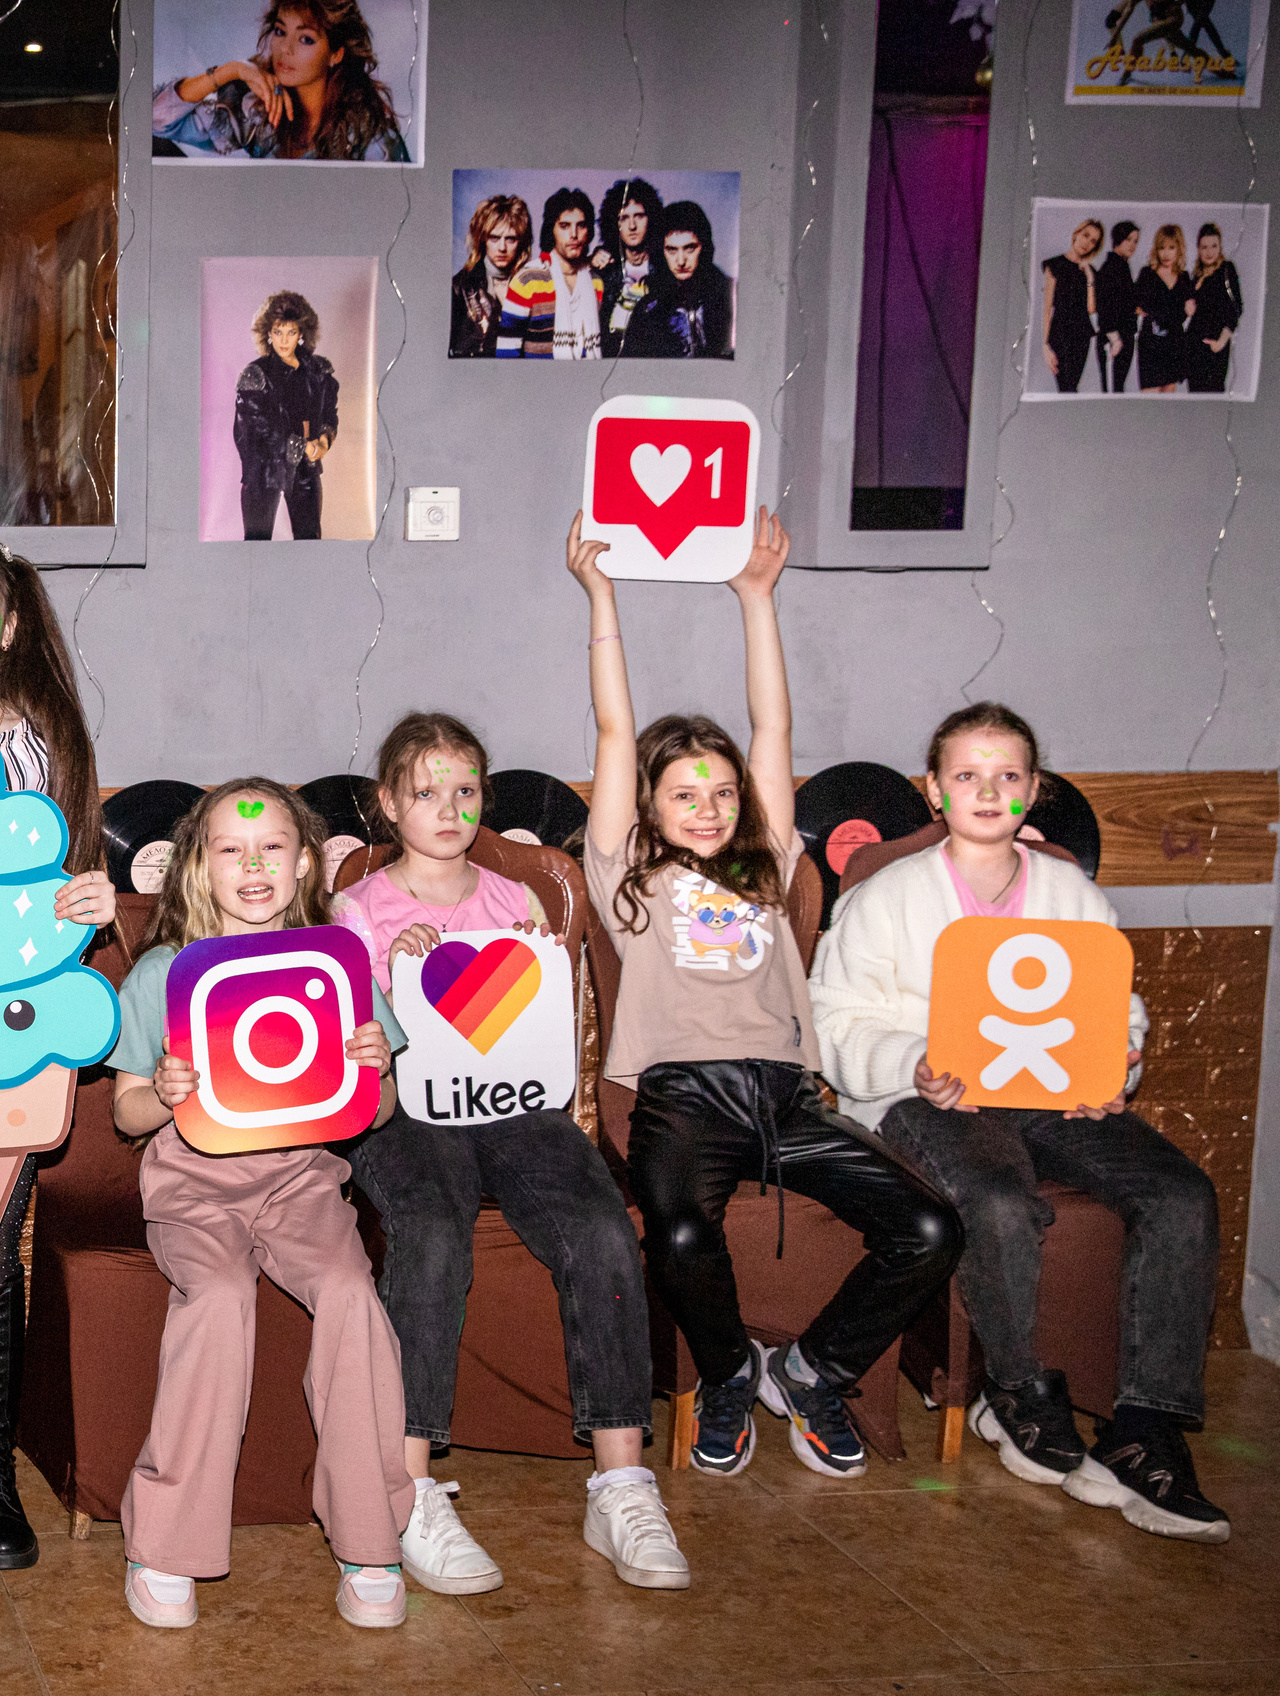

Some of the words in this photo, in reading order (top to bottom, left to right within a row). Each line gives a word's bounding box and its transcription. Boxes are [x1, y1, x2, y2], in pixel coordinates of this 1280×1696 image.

[1086, 45, 1236, 83] Arabesque
[704, 446, 723, 499] 1
[424, 1076, 546, 1121] Likee
